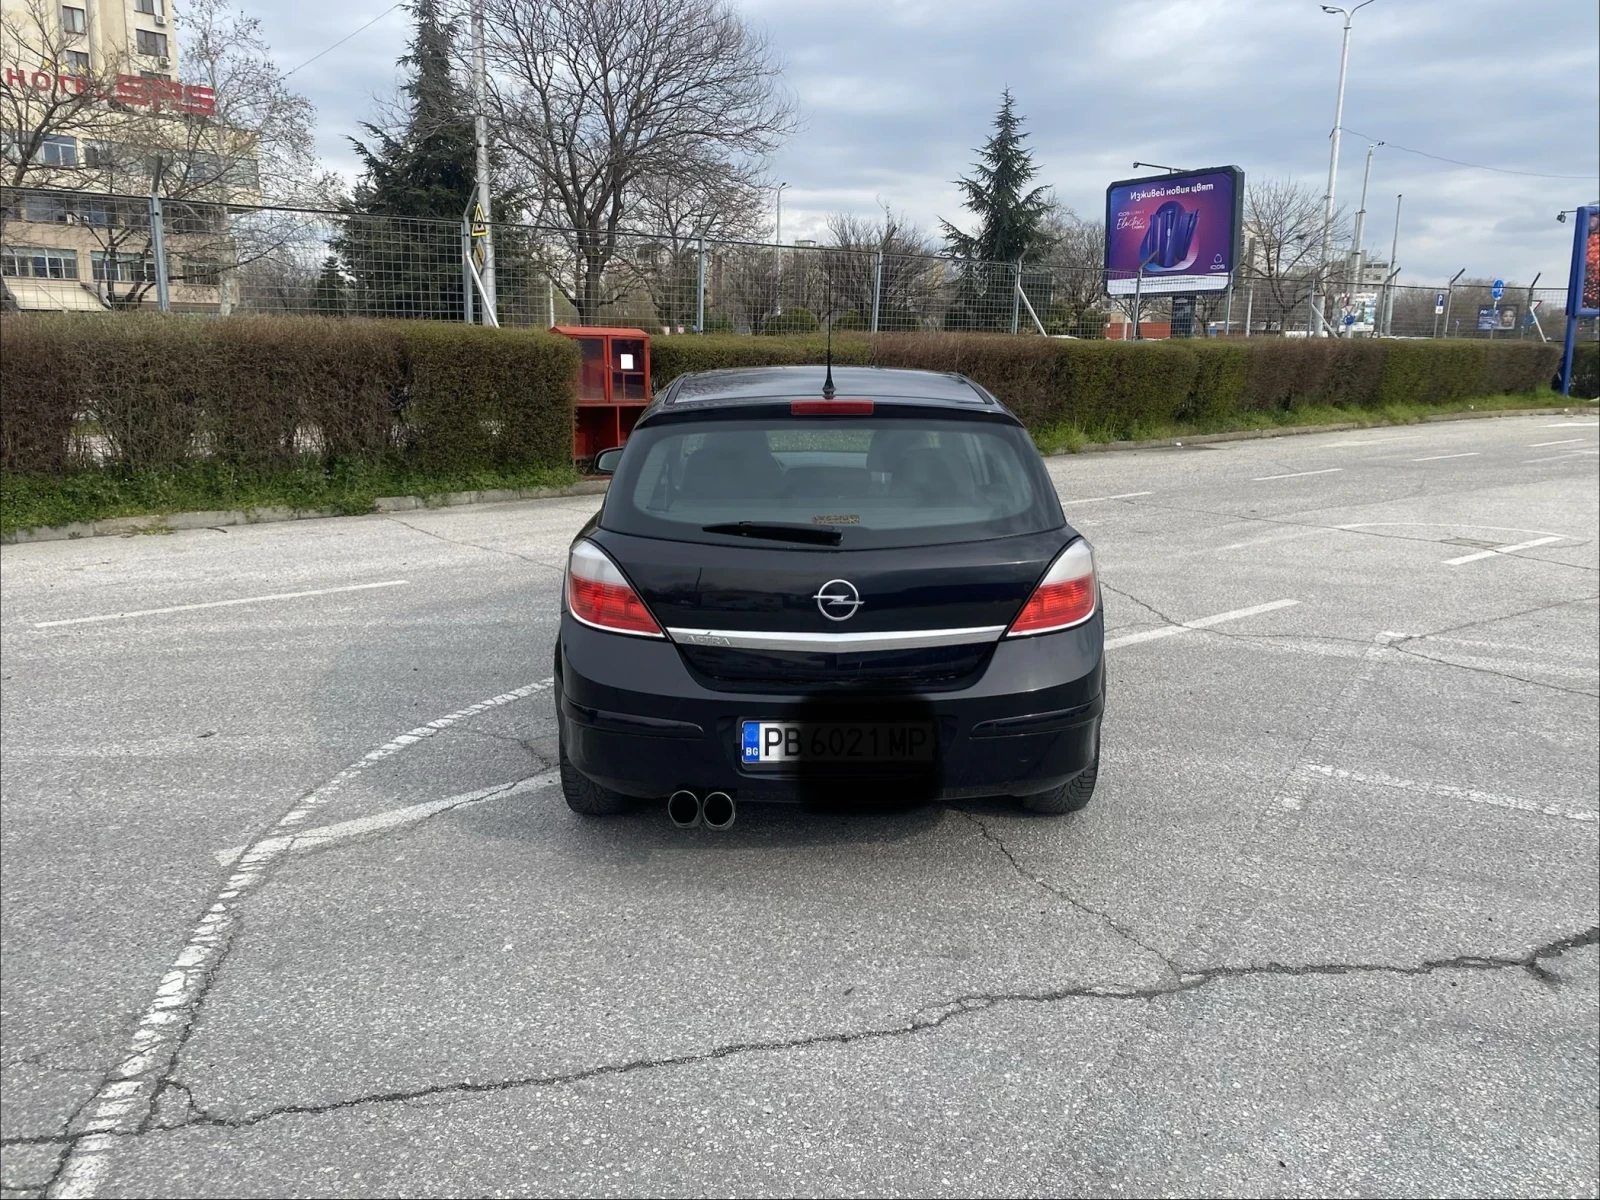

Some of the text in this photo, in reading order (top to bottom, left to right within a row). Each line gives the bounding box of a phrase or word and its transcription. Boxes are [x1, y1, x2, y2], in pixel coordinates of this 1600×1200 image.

[1130, 182, 1214, 201] Изживей новия цвят
[687, 634, 731, 645] ASTRA
[764, 727, 927, 757] PB 6021 MP
[745, 747, 759, 756] BG
